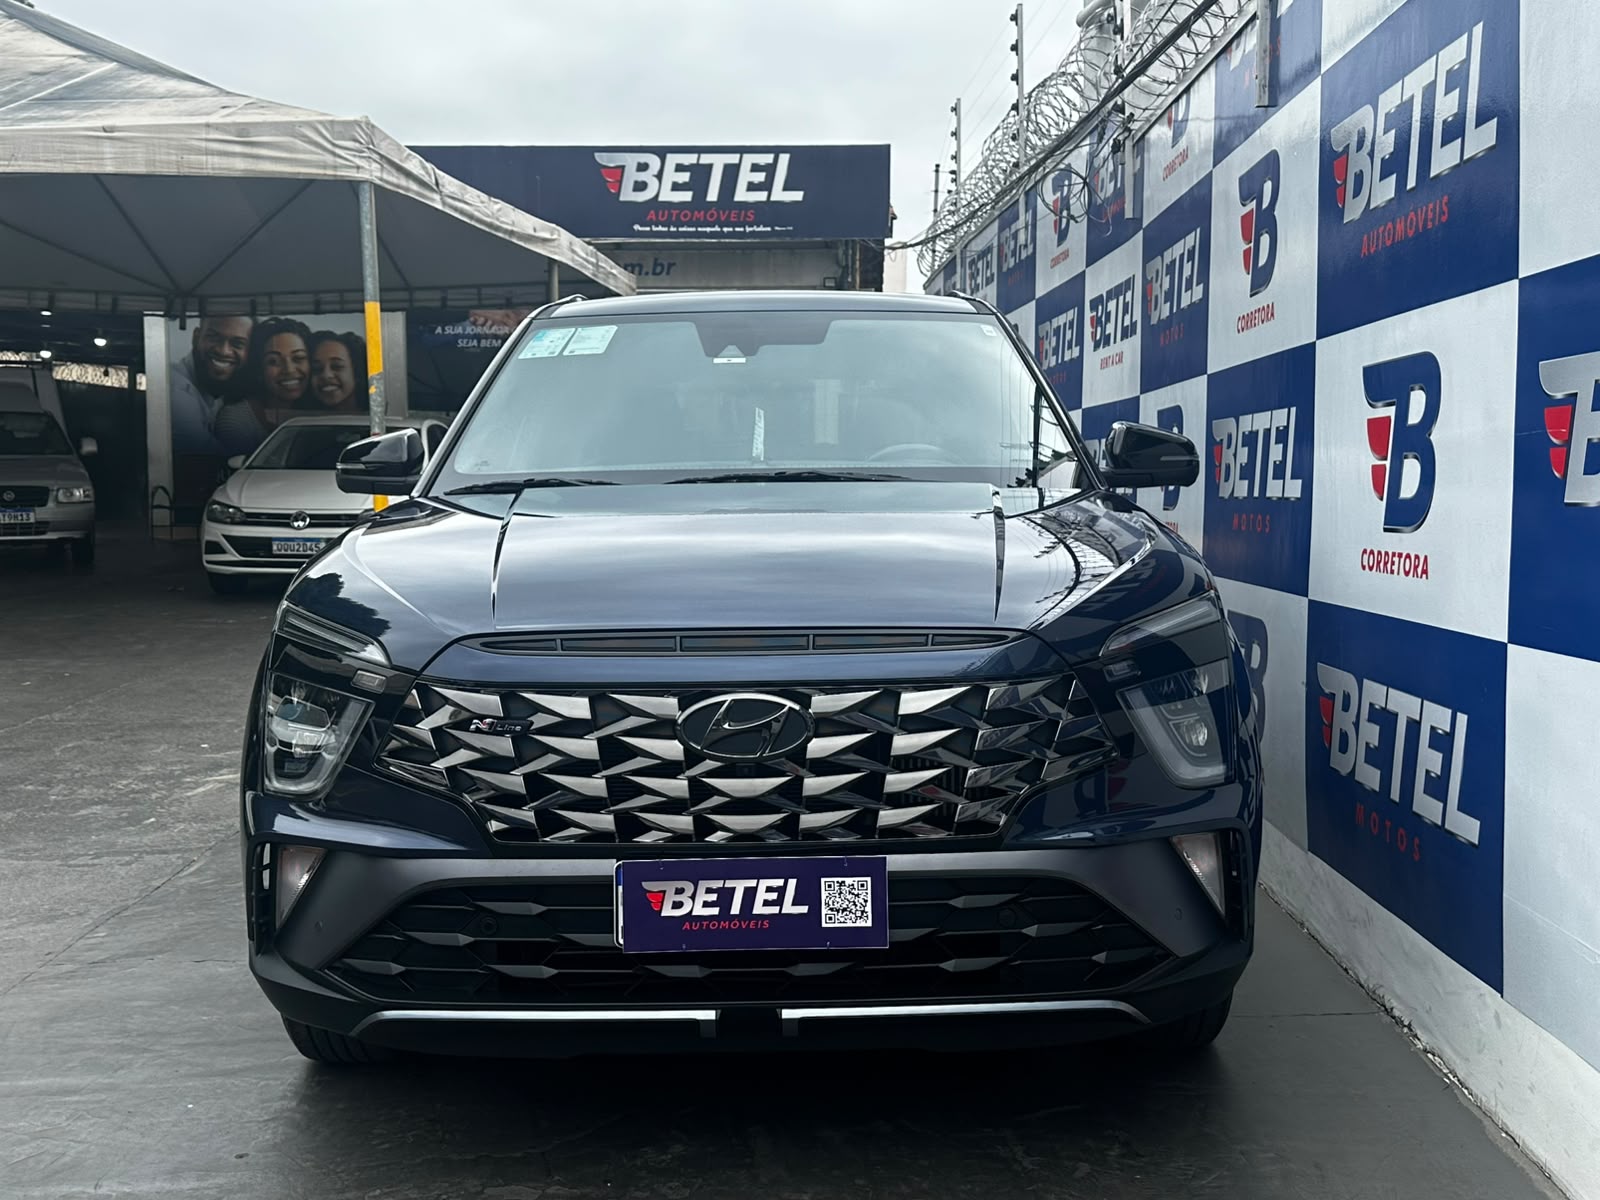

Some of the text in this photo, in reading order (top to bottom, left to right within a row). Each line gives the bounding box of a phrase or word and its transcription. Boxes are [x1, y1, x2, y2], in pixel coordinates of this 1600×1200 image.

[1331, 21, 1498, 226] BETEL
[594, 152, 805, 202] BETEL
[646, 207, 756, 222] AUTOMÓVEIS
[1361, 195, 1450, 258] AUTOMÓVEIS
[1146, 226, 1204, 325] BETEL
[444, 326, 463, 335] SUA
[1038, 306, 1080, 371] BETEL
[1089, 273, 1138, 352] BETEL
[1237, 301, 1276, 334] CORRETORA
[457, 339, 478, 347] SEJA
[1212, 406, 1302, 500] BETEL
[1362, 351, 1442, 533] B
[1232, 513, 1271, 533] MOTOS
[1361, 547, 1430, 580] CORRETORA
[1316, 661, 1481, 847] BETEL
[1355, 802, 1422, 862] MOTOS
[641, 878, 809, 917] BETEL
[682, 918, 770, 931] AUTOMÓVEIS
